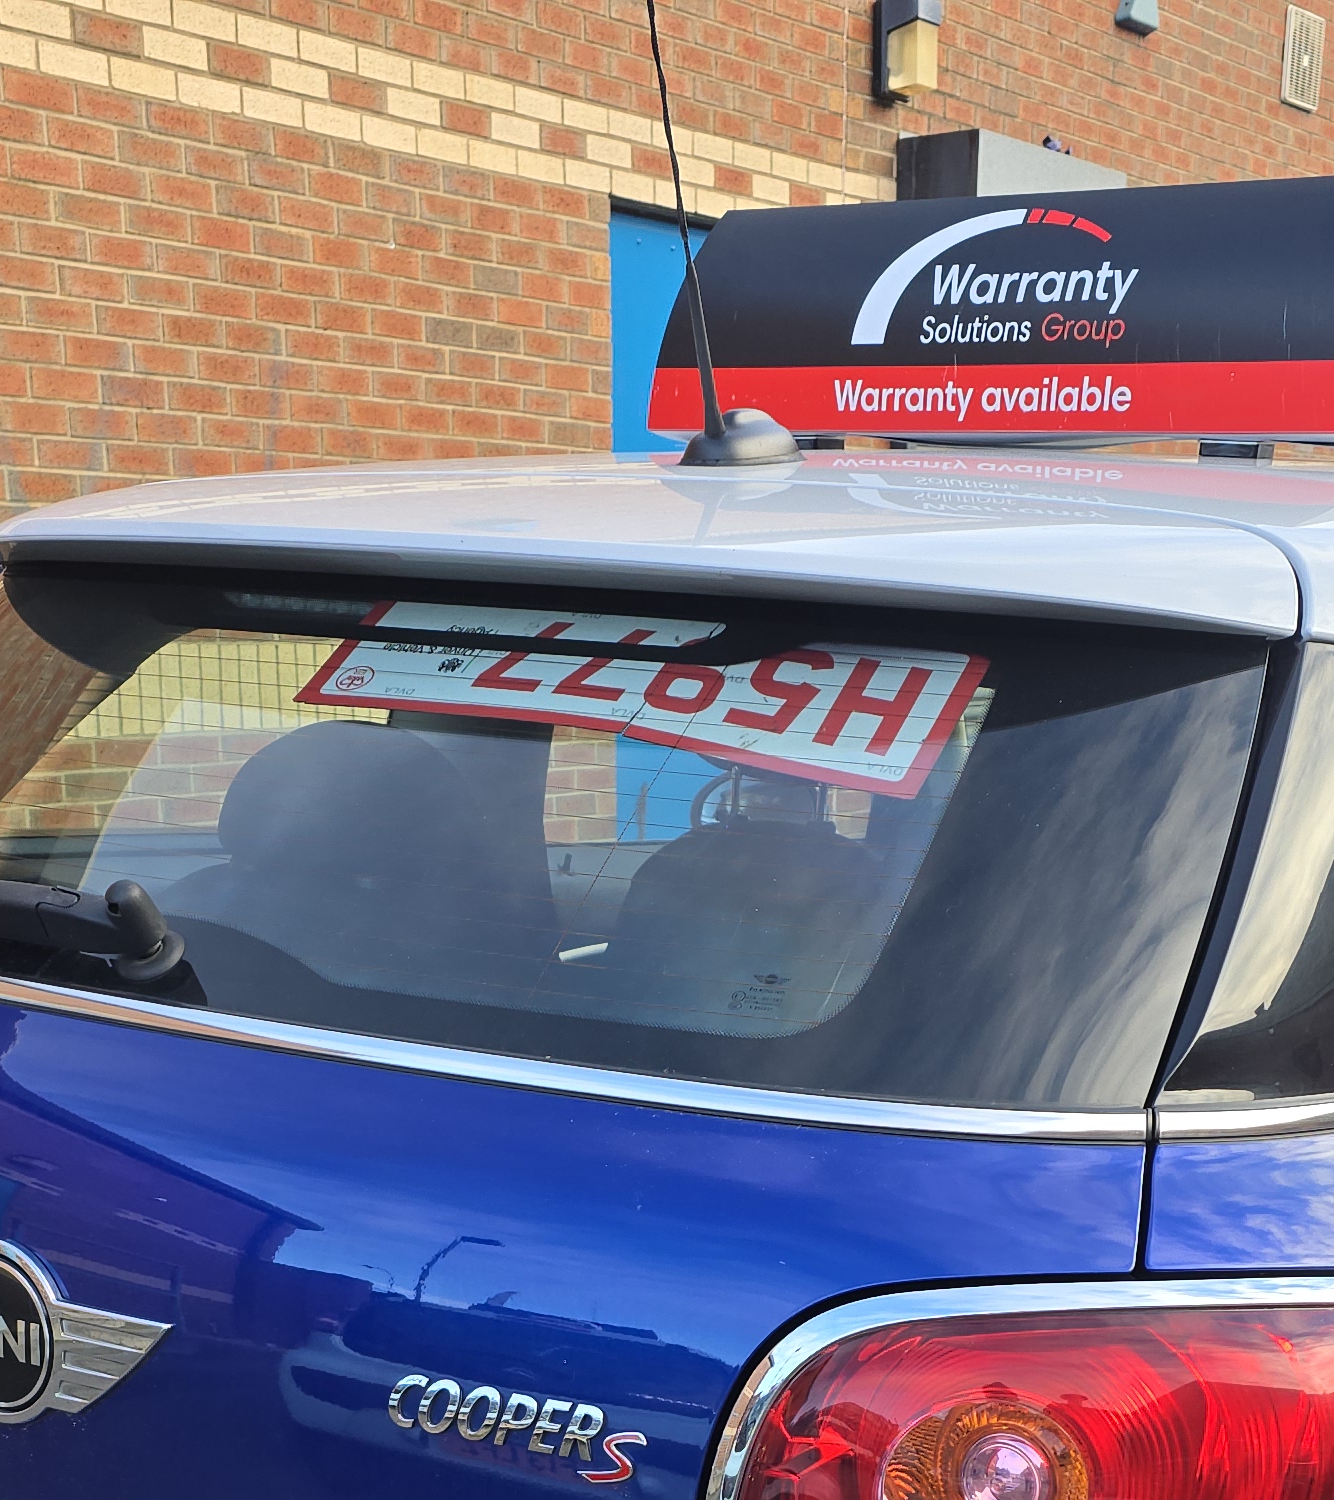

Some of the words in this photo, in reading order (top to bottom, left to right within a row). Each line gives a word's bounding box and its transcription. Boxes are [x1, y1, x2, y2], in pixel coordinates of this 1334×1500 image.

[931, 261, 1140, 315] Warranty
[919, 314, 1033, 346] Solutions
[1040, 313, 1127, 349] Group
[834, 379, 975, 422] Warranty
[981, 378, 1133, 413] available
[387, 1373, 605, 1462] COOPER
[576, 1431, 648, 1484] S
